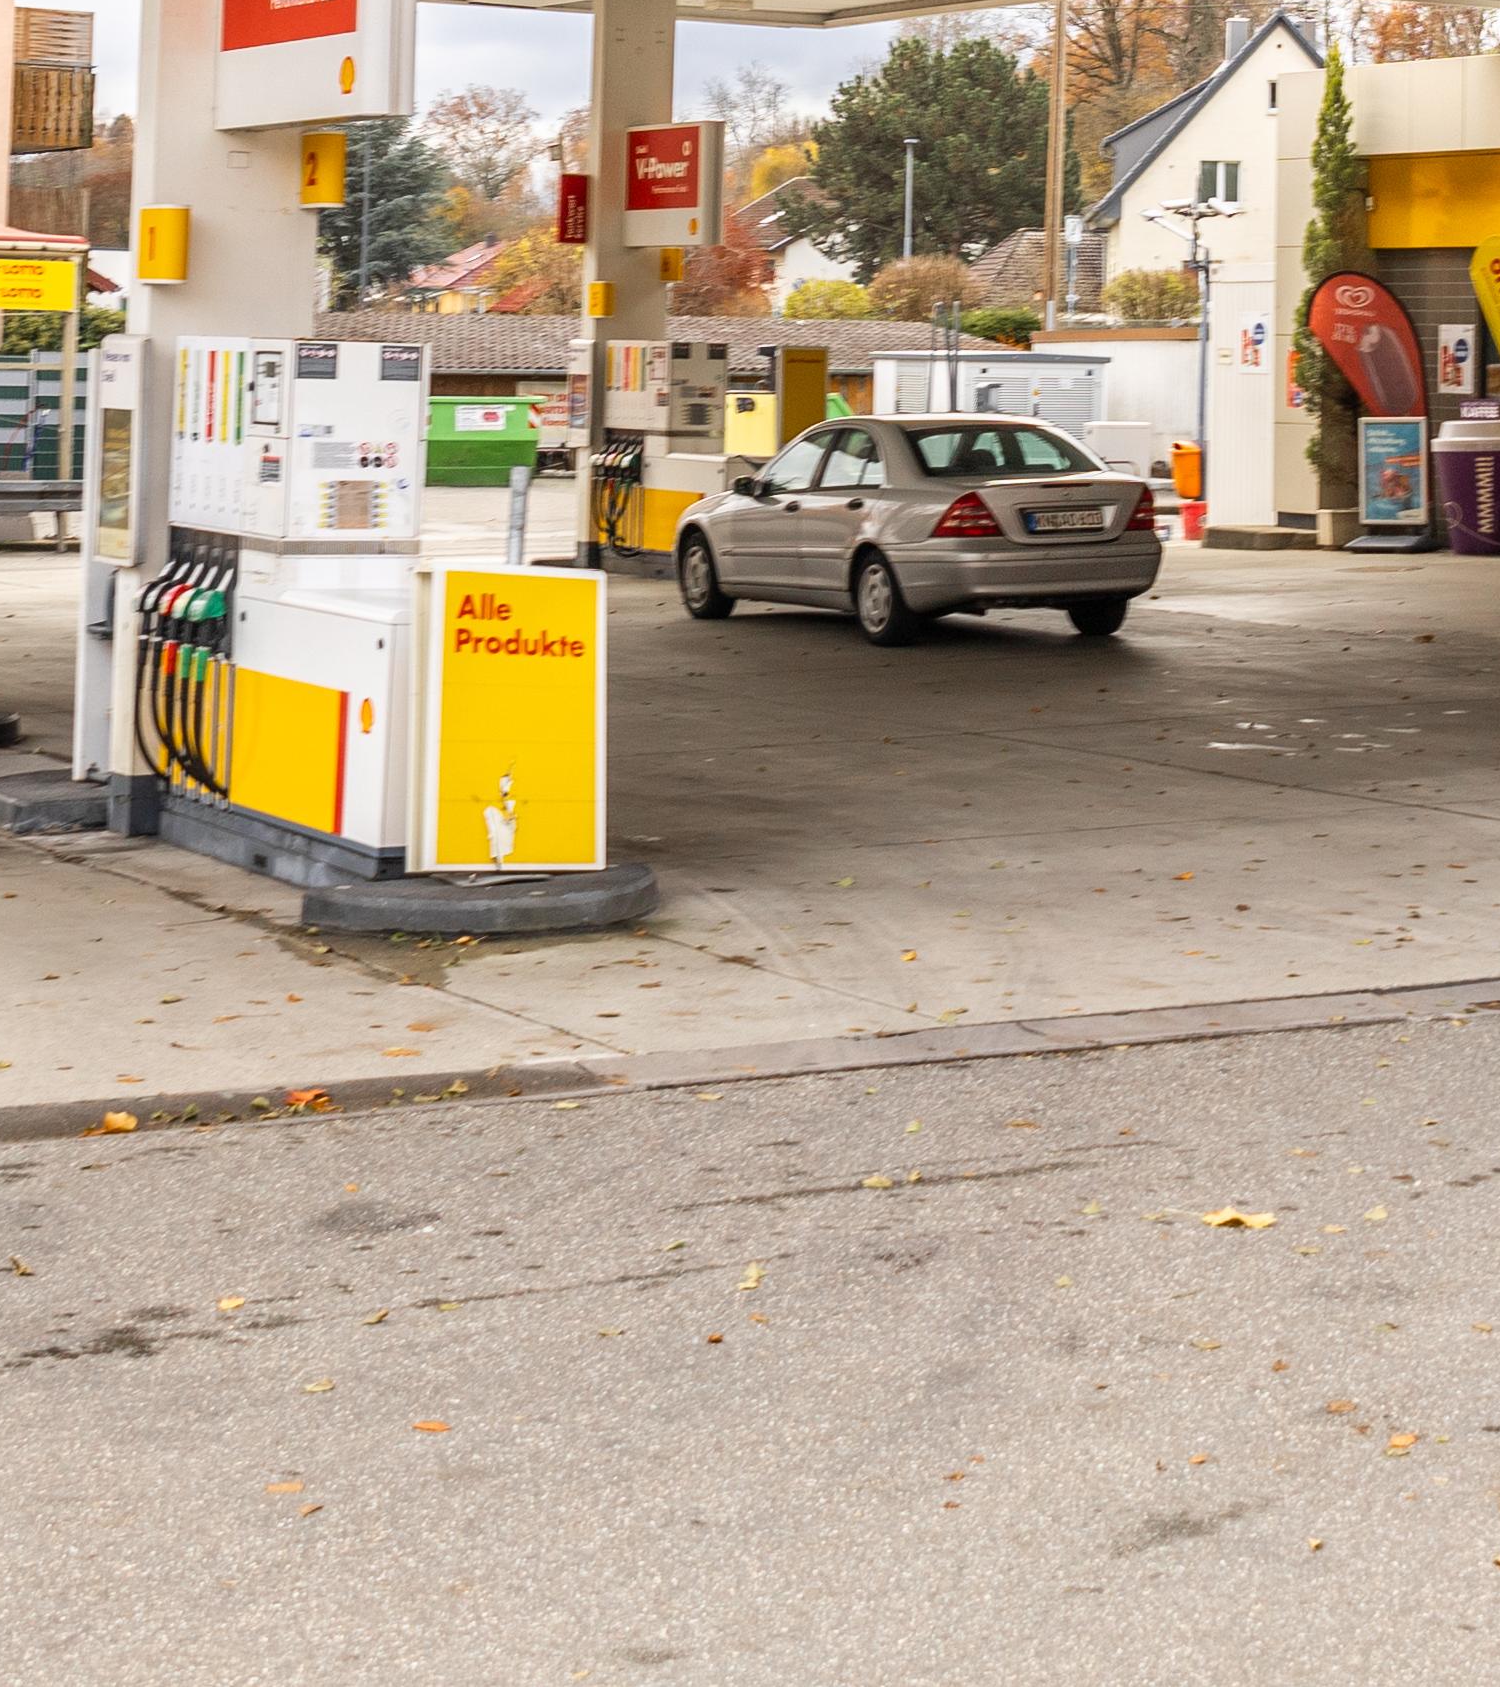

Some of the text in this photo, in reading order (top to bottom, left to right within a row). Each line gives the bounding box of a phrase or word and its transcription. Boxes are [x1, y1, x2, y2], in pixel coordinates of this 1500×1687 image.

[305, 151, 318, 187] 2
[635, 157, 689, 179] V-Power
[456, 593, 512, 621] Alle
[454, 628, 586, 658] Produkte
